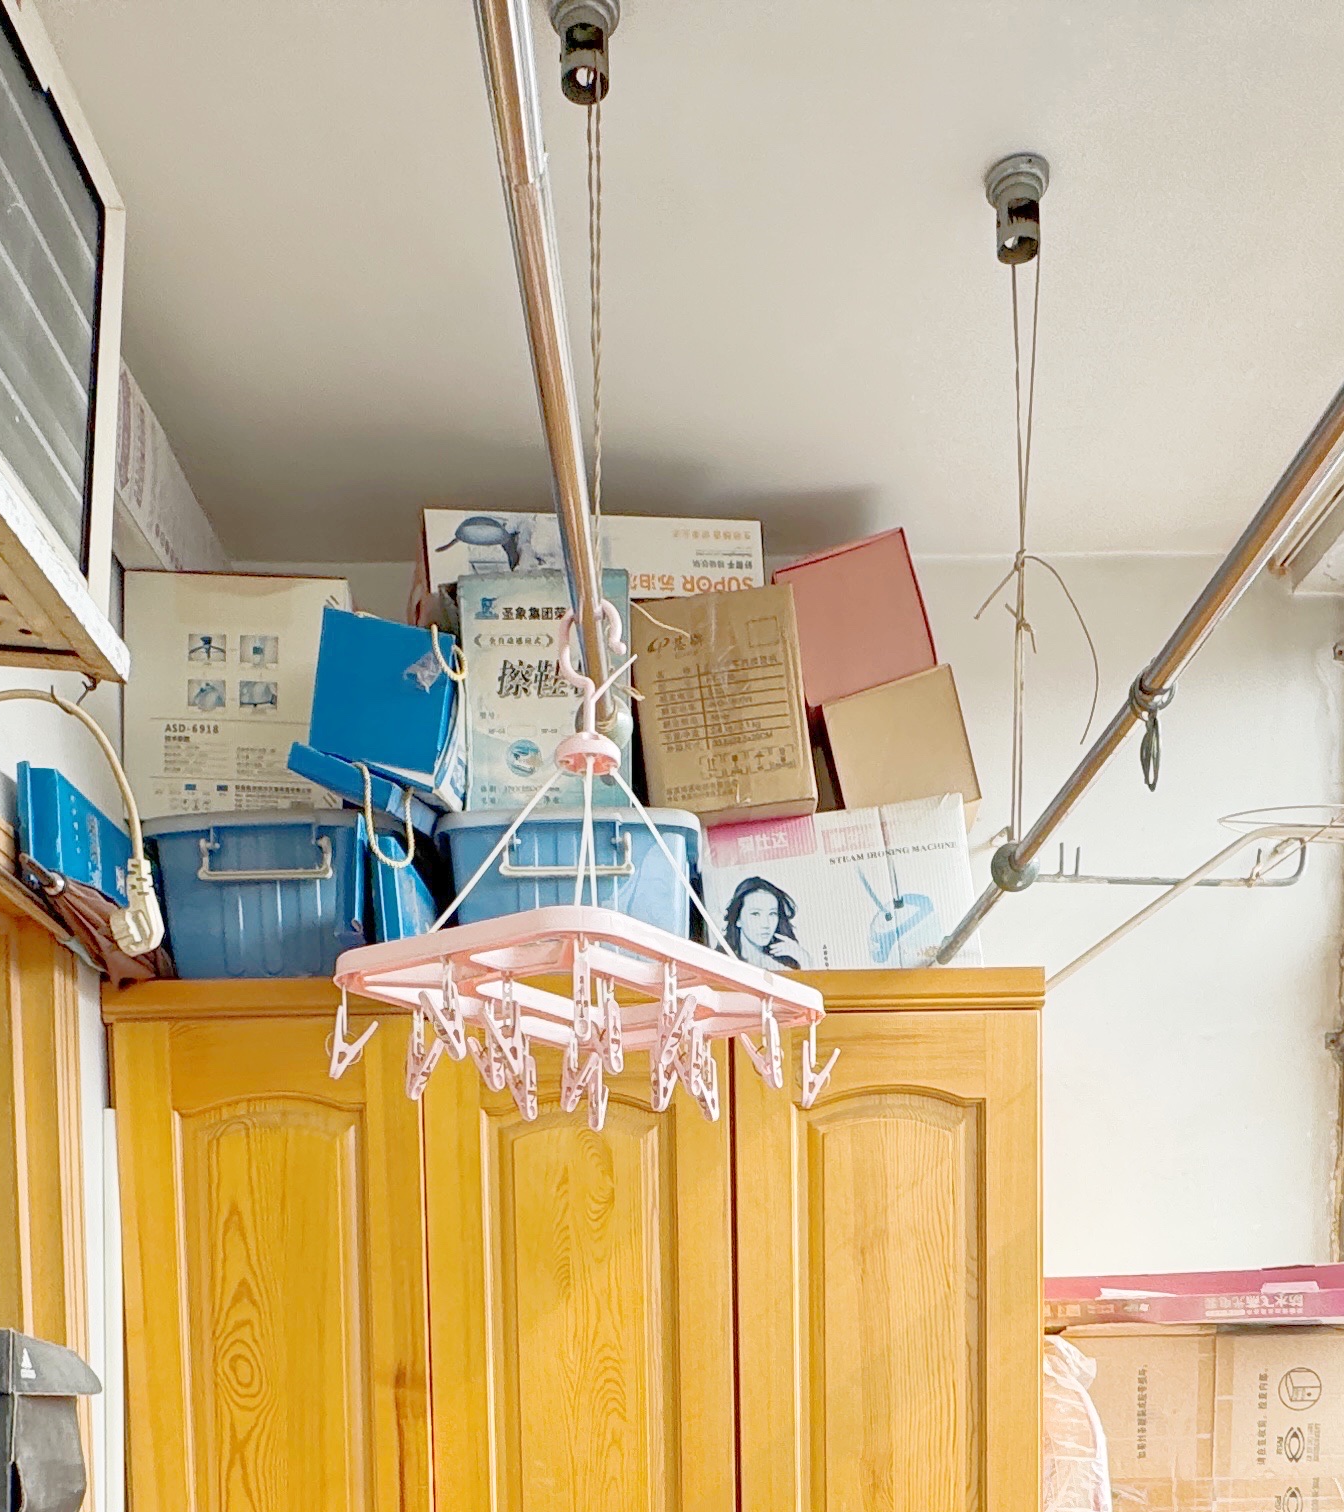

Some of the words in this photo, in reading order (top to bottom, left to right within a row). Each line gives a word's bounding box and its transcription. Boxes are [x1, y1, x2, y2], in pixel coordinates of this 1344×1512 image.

[682, 573, 754, 594] SUPOR
[497, 659, 587, 699] 擦鞋
[164, 723, 220, 735] ASD-6918
[828, 853, 865, 866] STEAM
[866, 845, 910, 861] IRONING
[911, 841, 958, 854] MACHINE
